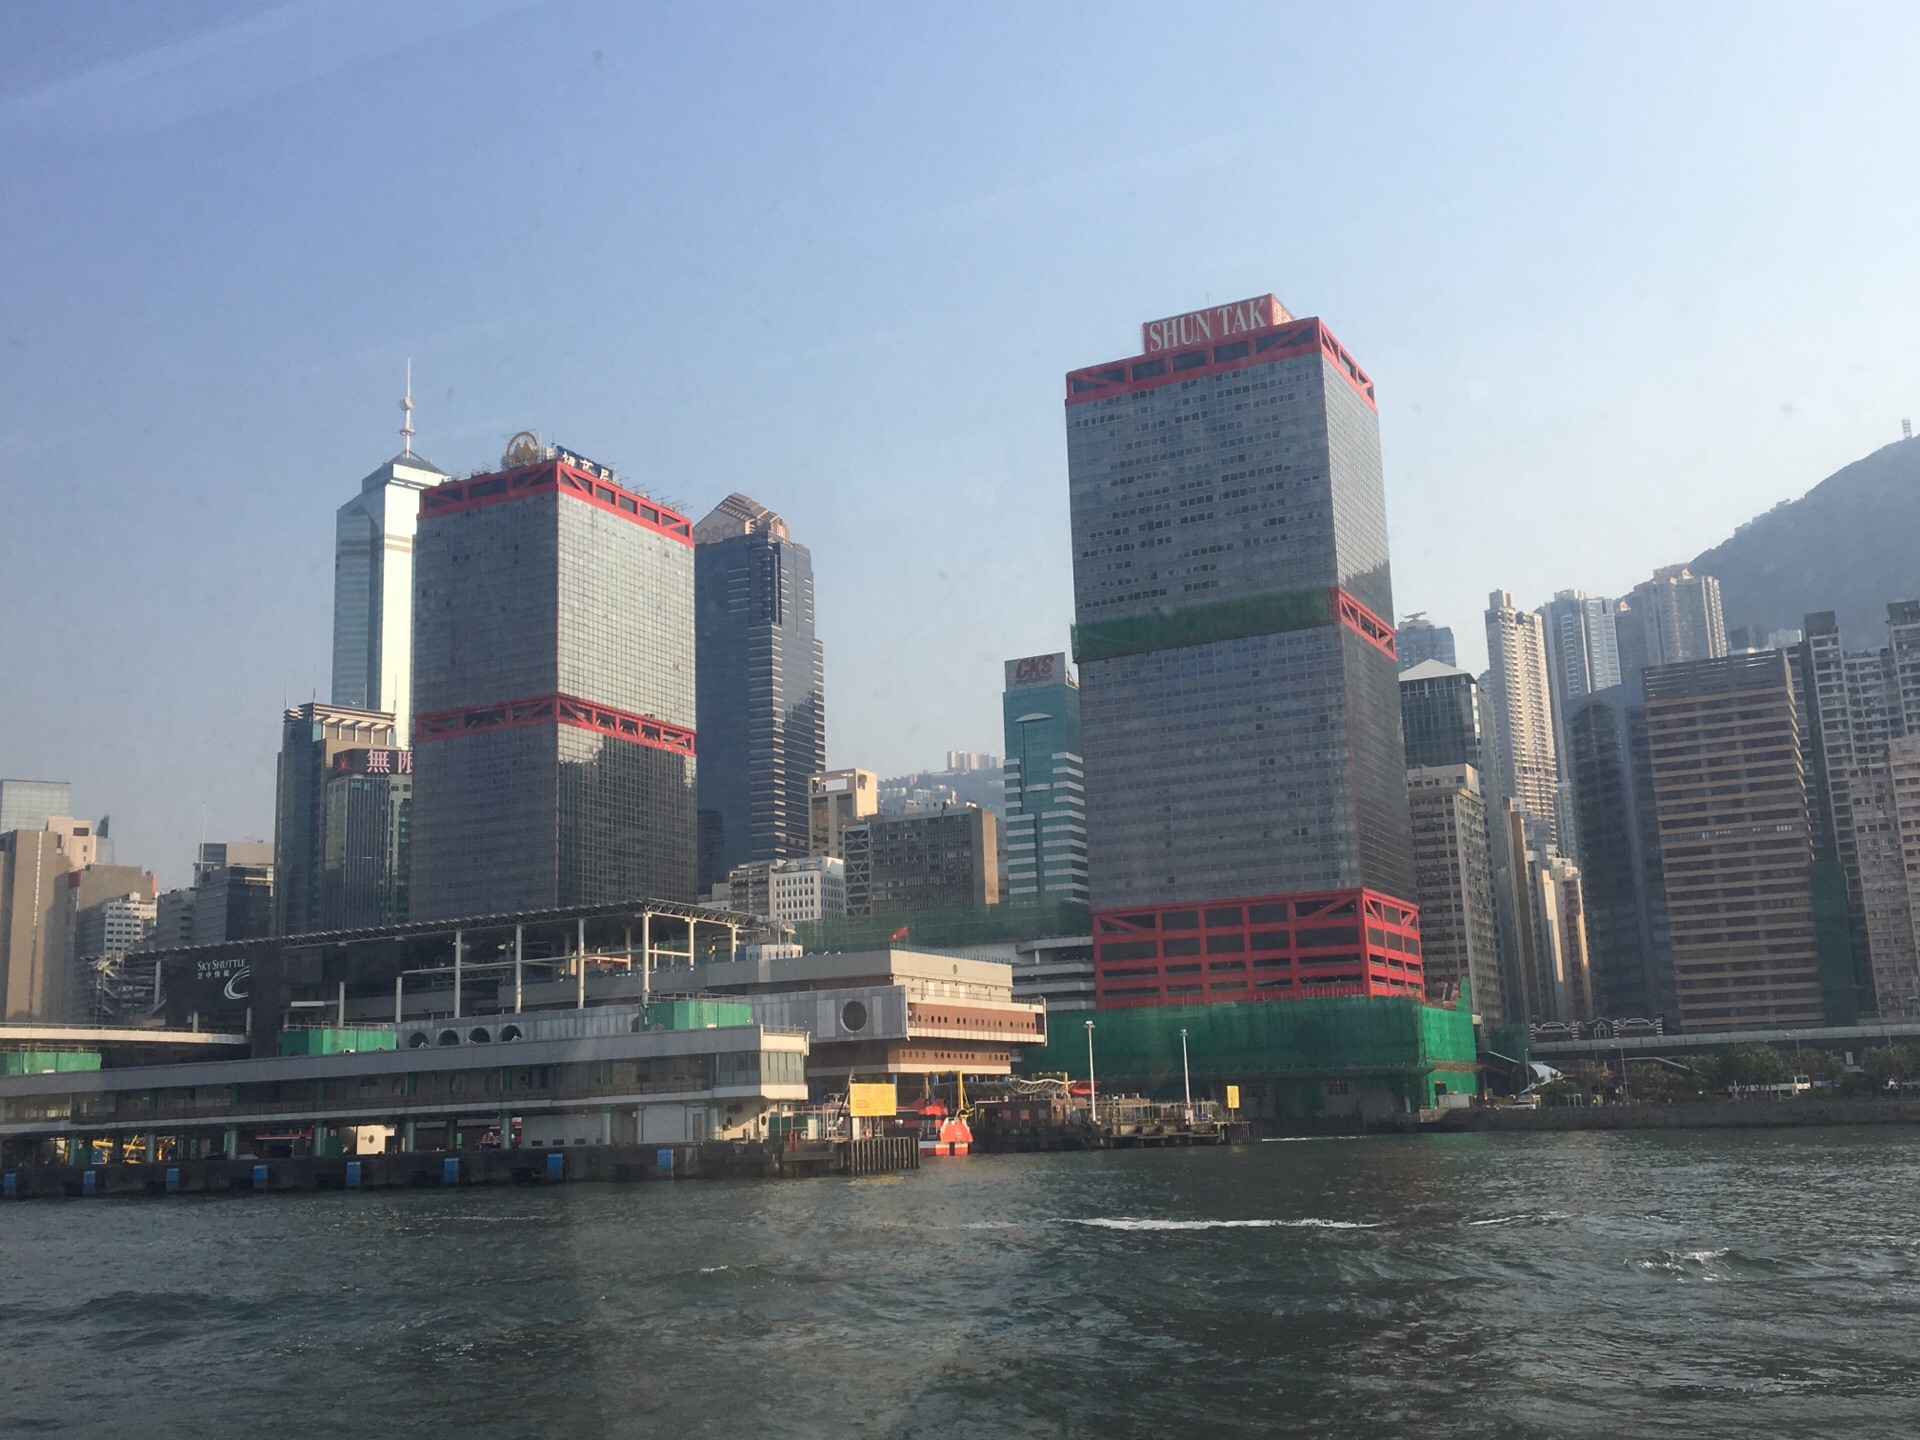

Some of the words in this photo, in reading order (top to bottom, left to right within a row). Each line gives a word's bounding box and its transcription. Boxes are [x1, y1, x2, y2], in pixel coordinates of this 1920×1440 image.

[1148, 310, 1211, 352] SHUN
[1216, 298, 1267, 337] TAK
[1016, 655, 1055, 679] CKS
[197, 960, 211, 971] SKY
[212, 959, 246, 970] SHUTTLE
